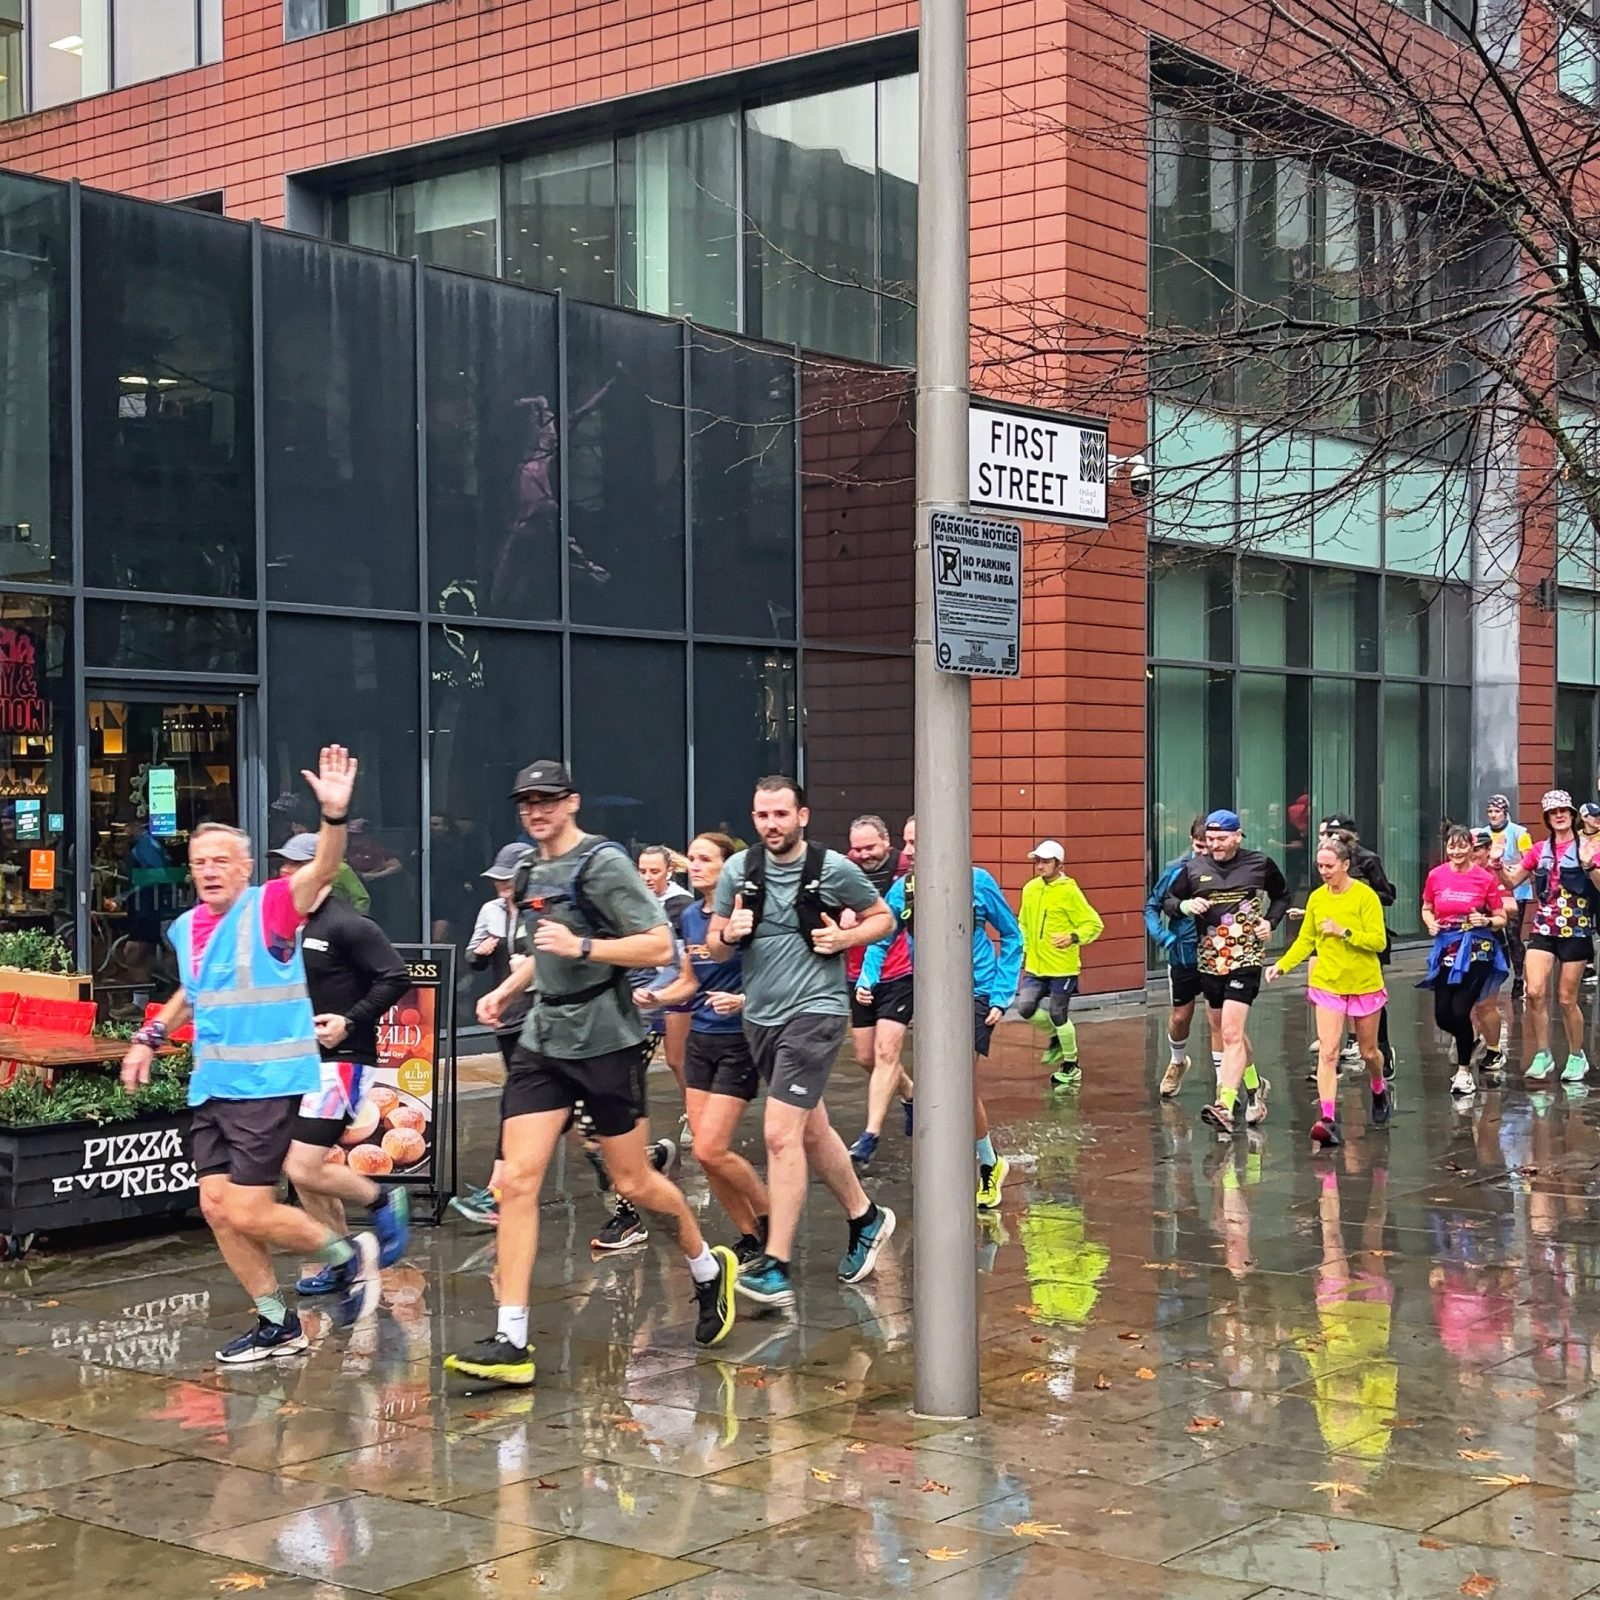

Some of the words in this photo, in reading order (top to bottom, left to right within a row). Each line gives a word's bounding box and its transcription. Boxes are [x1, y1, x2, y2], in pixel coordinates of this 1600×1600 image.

[990, 420, 1059, 463] FIRST
[978, 462, 1069, 507] STREET
[934, 520, 979, 538] PARKING
[982, 527, 1018, 544] NOTICE
[935, 533, 944, 541] NO
[992, 542, 1018, 552] PARKING
[962, 555, 975, 567] NO
[976, 557, 1011, 572] PARKING
[962, 569, 972, 581] IN
[973, 571, 992, 583] THIS
[993, 574, 1014, 586] AREA
[82, 1128, 184, 1170] PIZZA
